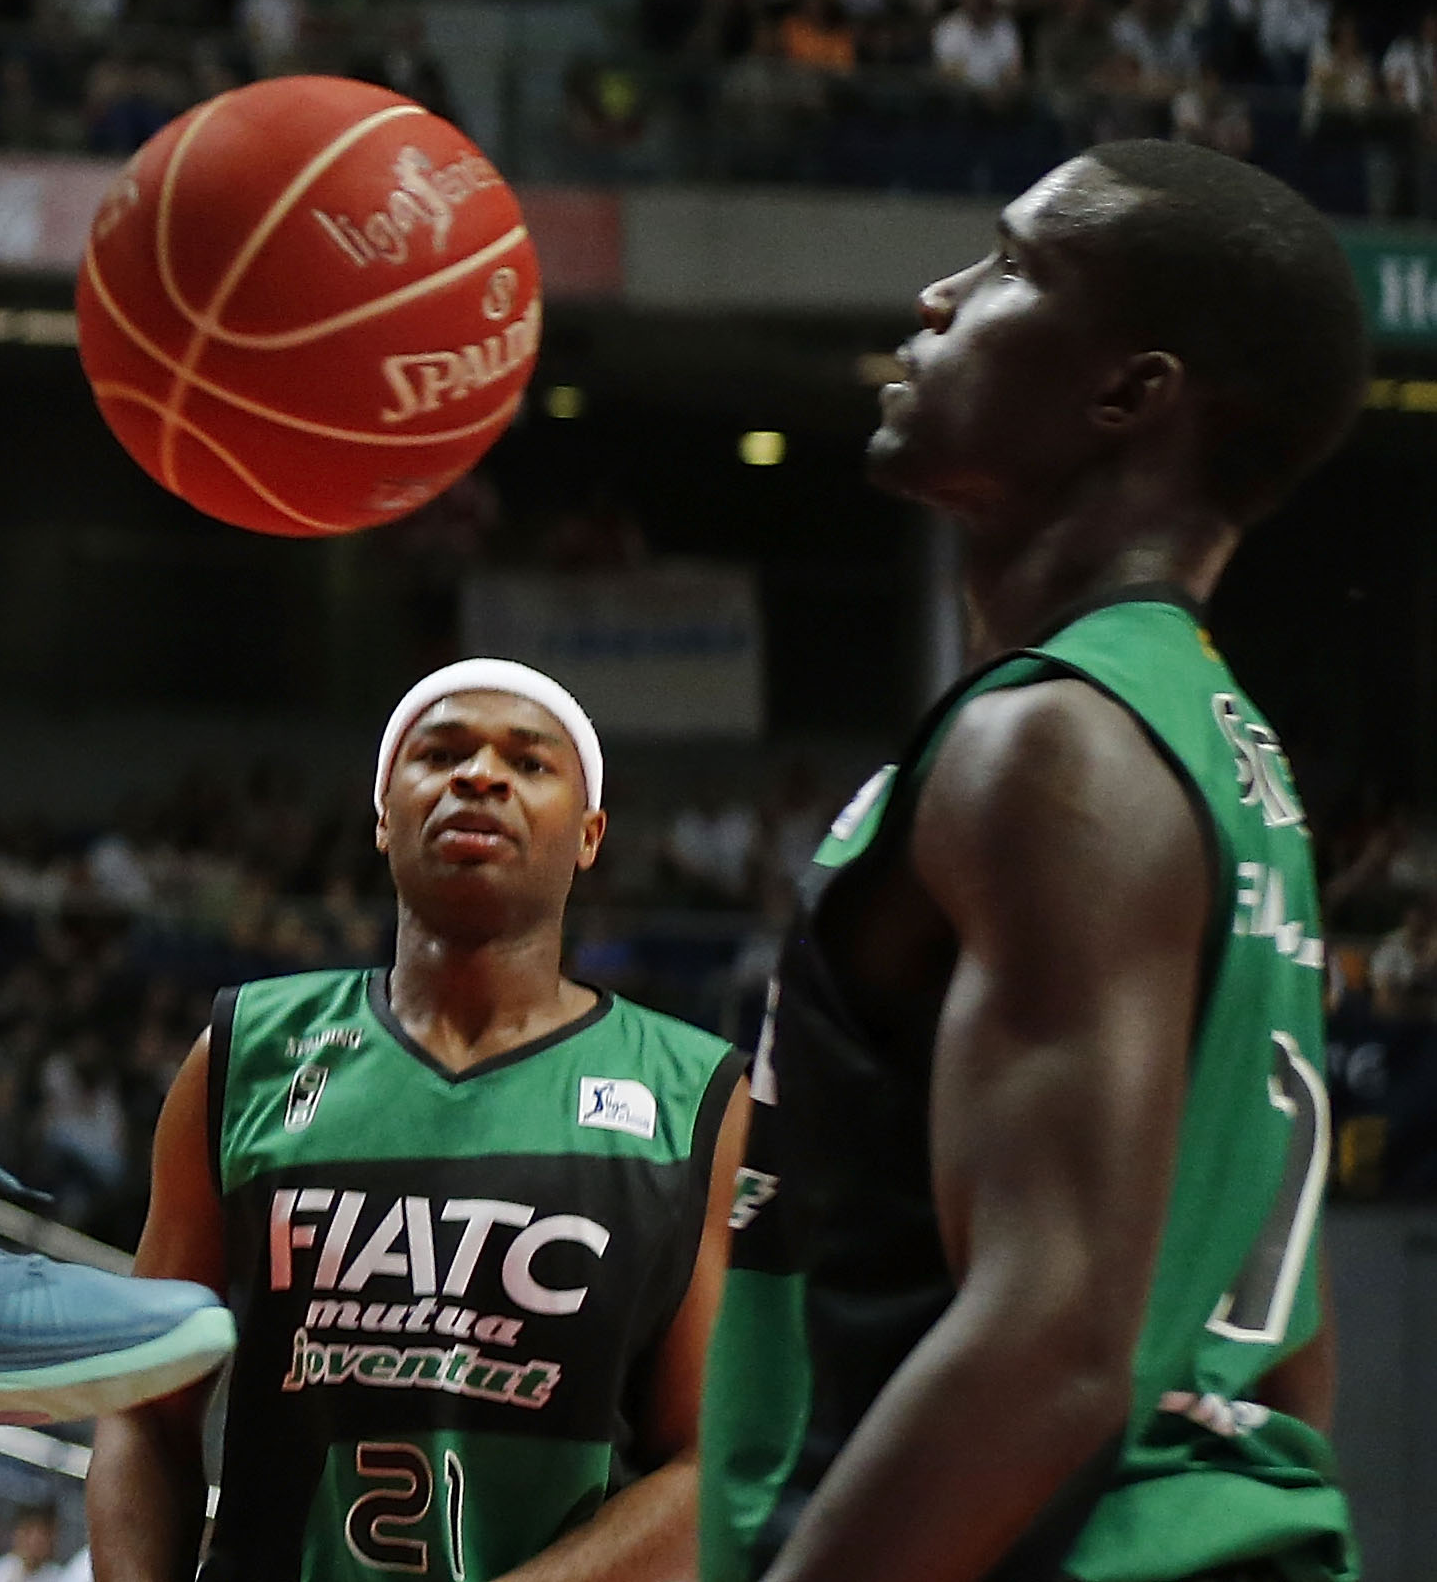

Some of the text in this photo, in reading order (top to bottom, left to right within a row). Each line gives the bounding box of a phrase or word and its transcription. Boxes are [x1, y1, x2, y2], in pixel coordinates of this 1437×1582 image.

[269, 1187, 611, 1316] FIATC
[281, 1326, 563, 1410] joventut
[305, 1297, 526, 1348] mutua
[343, 1441, 466, 1582] 21
